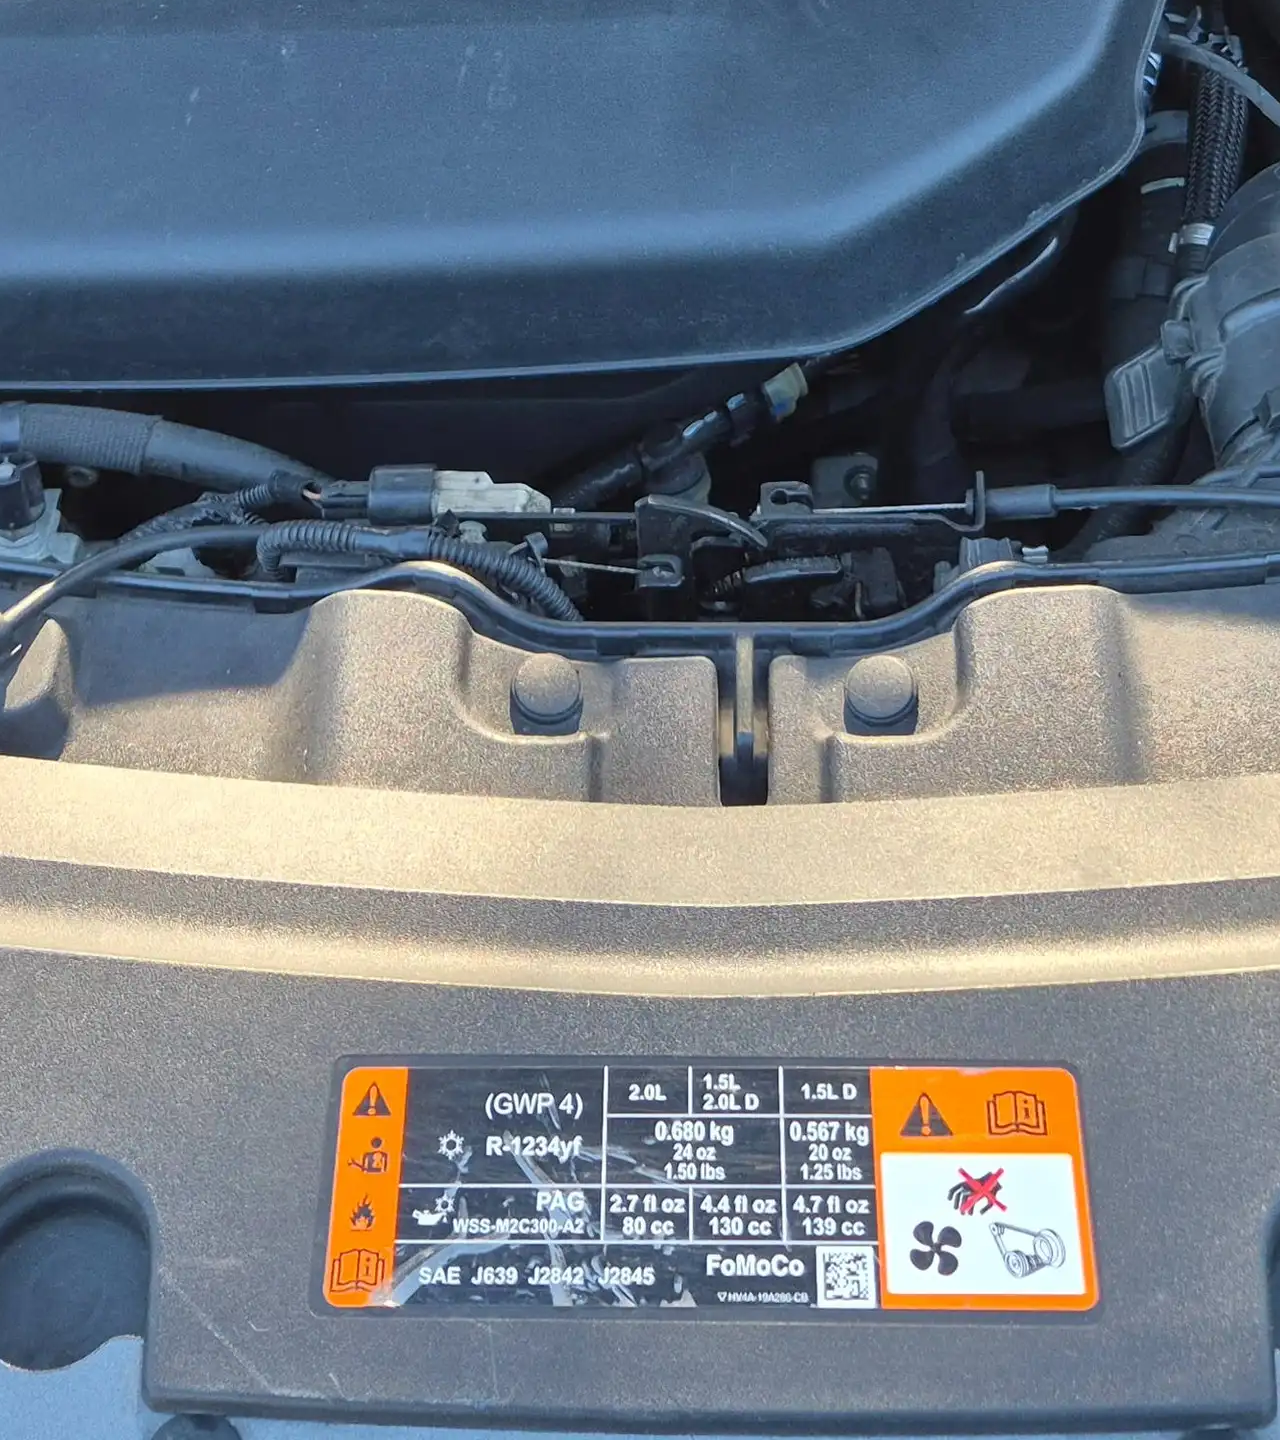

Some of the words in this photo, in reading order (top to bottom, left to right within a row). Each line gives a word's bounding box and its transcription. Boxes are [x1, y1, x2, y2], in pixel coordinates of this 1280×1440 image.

[702, 1072, 741, 1090] 1.5L
[628, 1083, 667, 1101] 2.0L
[801, 1082, 839, 1100] 1.5L
[842, 1083, 857, 1100] D
[485, 1092, 554, 1120] (GWP
[558, 1092, 584, 1120] 4)
[702, 1093, 741, 1111] 2.0L
[744, 1093, 759, 1110] D
[654, 1120, 706, 1141] 0.680
[709, 1120, 734, 1146] kg
[789, 1121, 839, 1141] 0.567
[844, 1121, 869, 1146] kg
[485, 1135, 583, 1164] R-1234yf
[672, 1142, 693, 1161] 24
[696, 1146, 717, 1161] oz
[808, 1143, 828, 1161] 20
[831, 1147, 852, 1161] oz
[664, 1162, 697, 1180] 1.50
[700, 1162, 726, 1180] lbs
[800, 1162, 834, 1180] 1.25
[837, 1162, 862, 1180] lbs
[536, 1189, 585, 1212] PAG
[609, 1194, 638, 1213] 2.7
[643, 1194, 657, 1213] fl
[661, 1199, 686, 1213] oz
[700, 1194, 730, 1213] 4.4
[734, 1194, 748, 1213] fl
[752, 1199, 777, 1213] oz
[792, 1194, 823, 1213] 4.7
[827, 1194, 841, 1213] fl
[845, 1199, 870, 1213] oz
[452, 1218, 585, 1234] WSS-M2C300-A2
[622, 1218, 646, 1235] 80
[650, 1223, 674, 1235] cc
[709, 1217, 743, 1235] 130
[747, 1222, 772, 1235] cc
[802, 1217, 835, 1235] 139
[841, 1222, 865, 1235] cc
[706, 1253, 804, 1276] FoMoCo
[418, 1266, 461, 1285] SAE
[471, 1266, 518, 1285] J639
[527, 1266, 584, 1285] J2842
[598, 1266, 655, 1285] J2845
